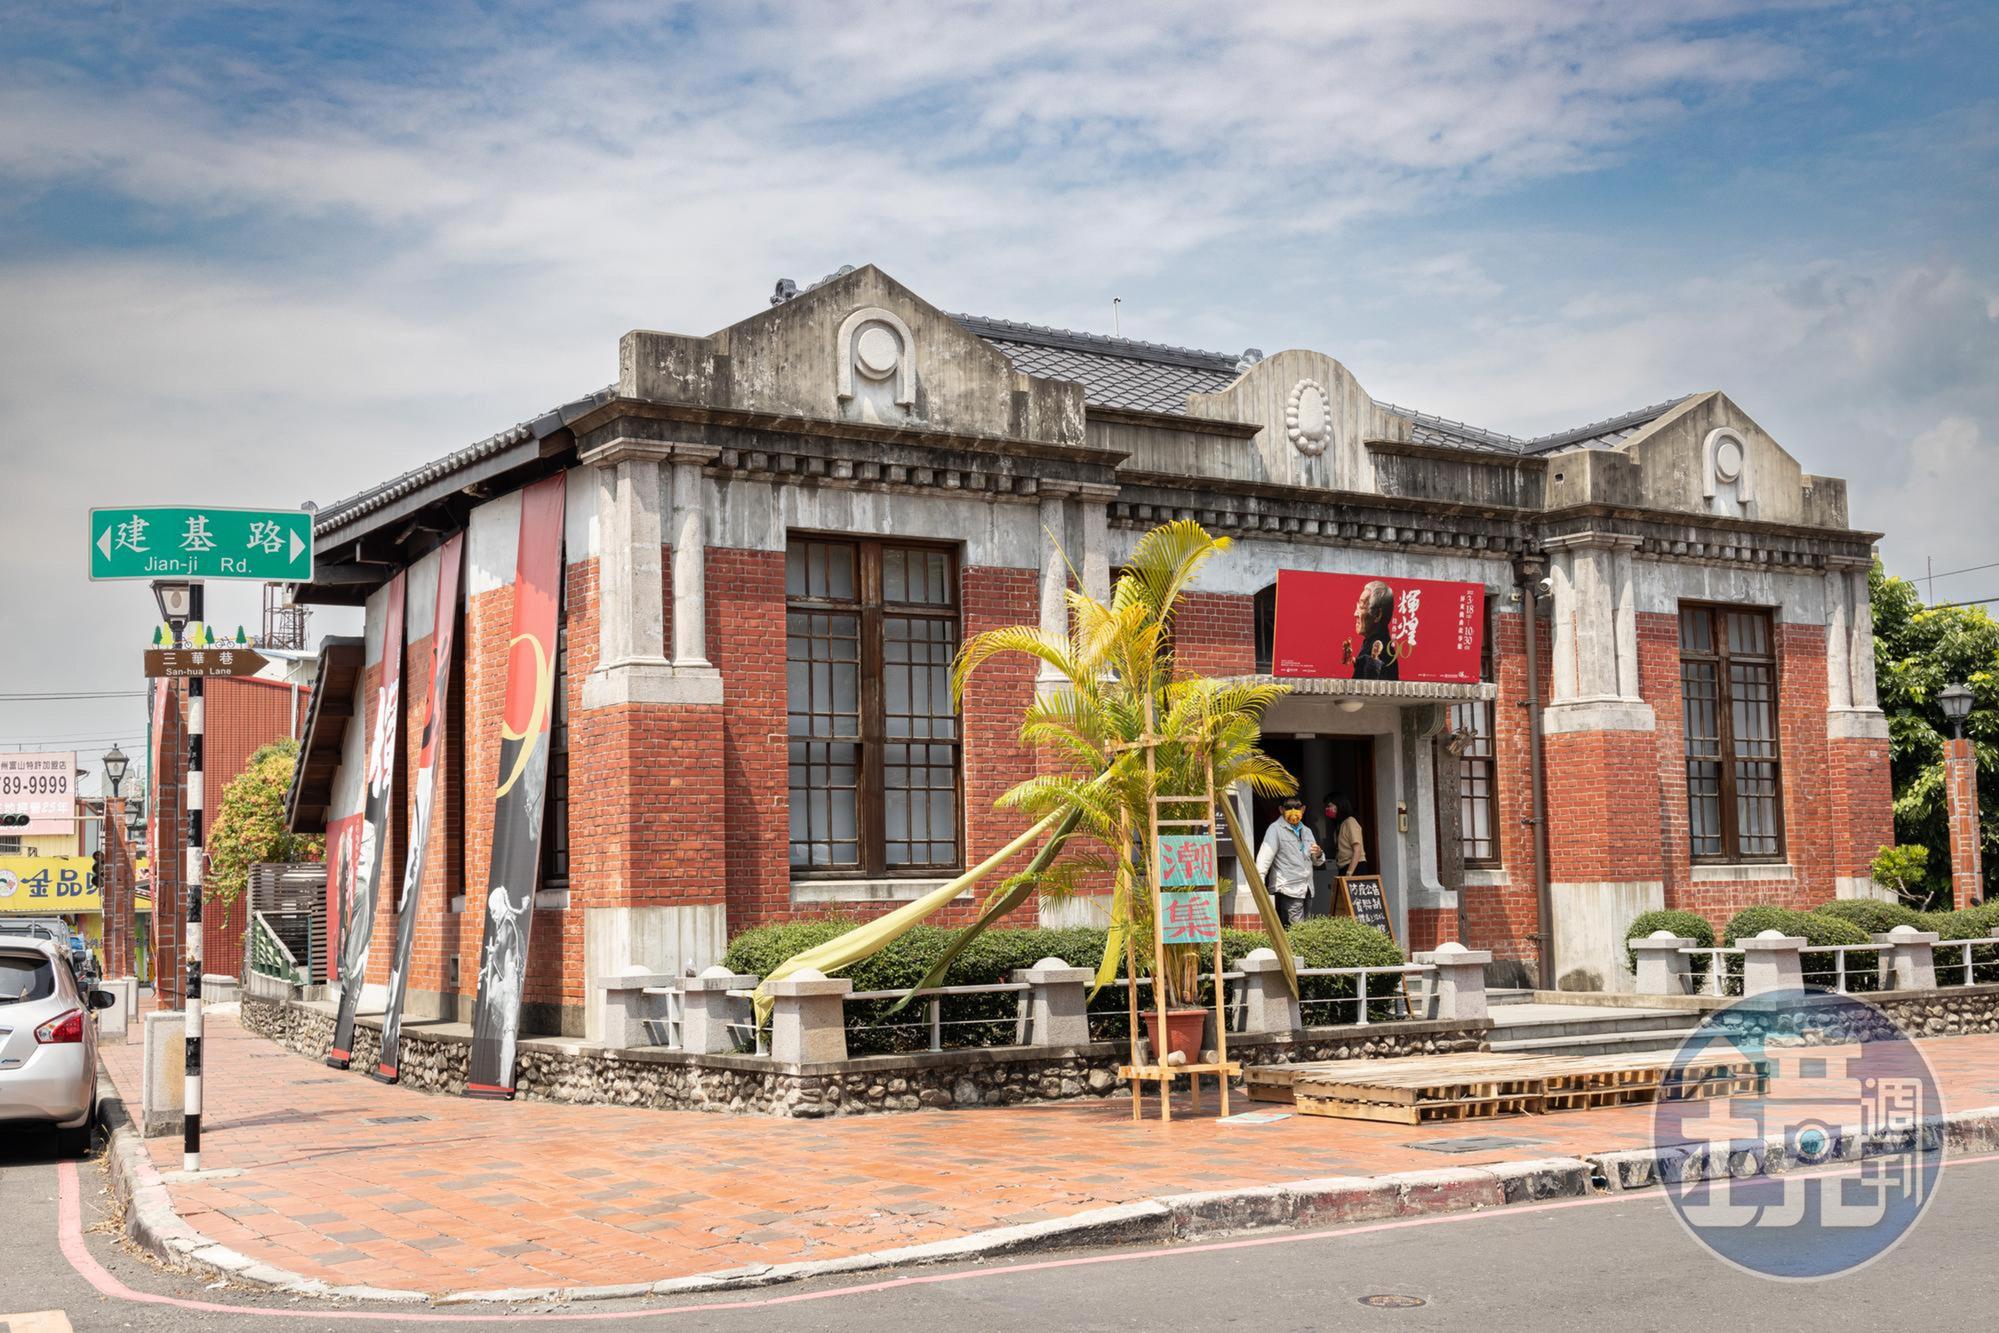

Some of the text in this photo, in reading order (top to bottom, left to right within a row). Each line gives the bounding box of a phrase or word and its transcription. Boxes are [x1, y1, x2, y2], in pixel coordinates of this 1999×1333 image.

[114, 514, 287, 555] 建基路
[144, 556, 252, 574] Jian-ji Rd.
[163, 651, 234, 665] 三華巷
[1385, 640, 1413, 668] 90
[166, 667, 232, 677] San-hua Lane
[0, 775, 67, 795] 89-9999
